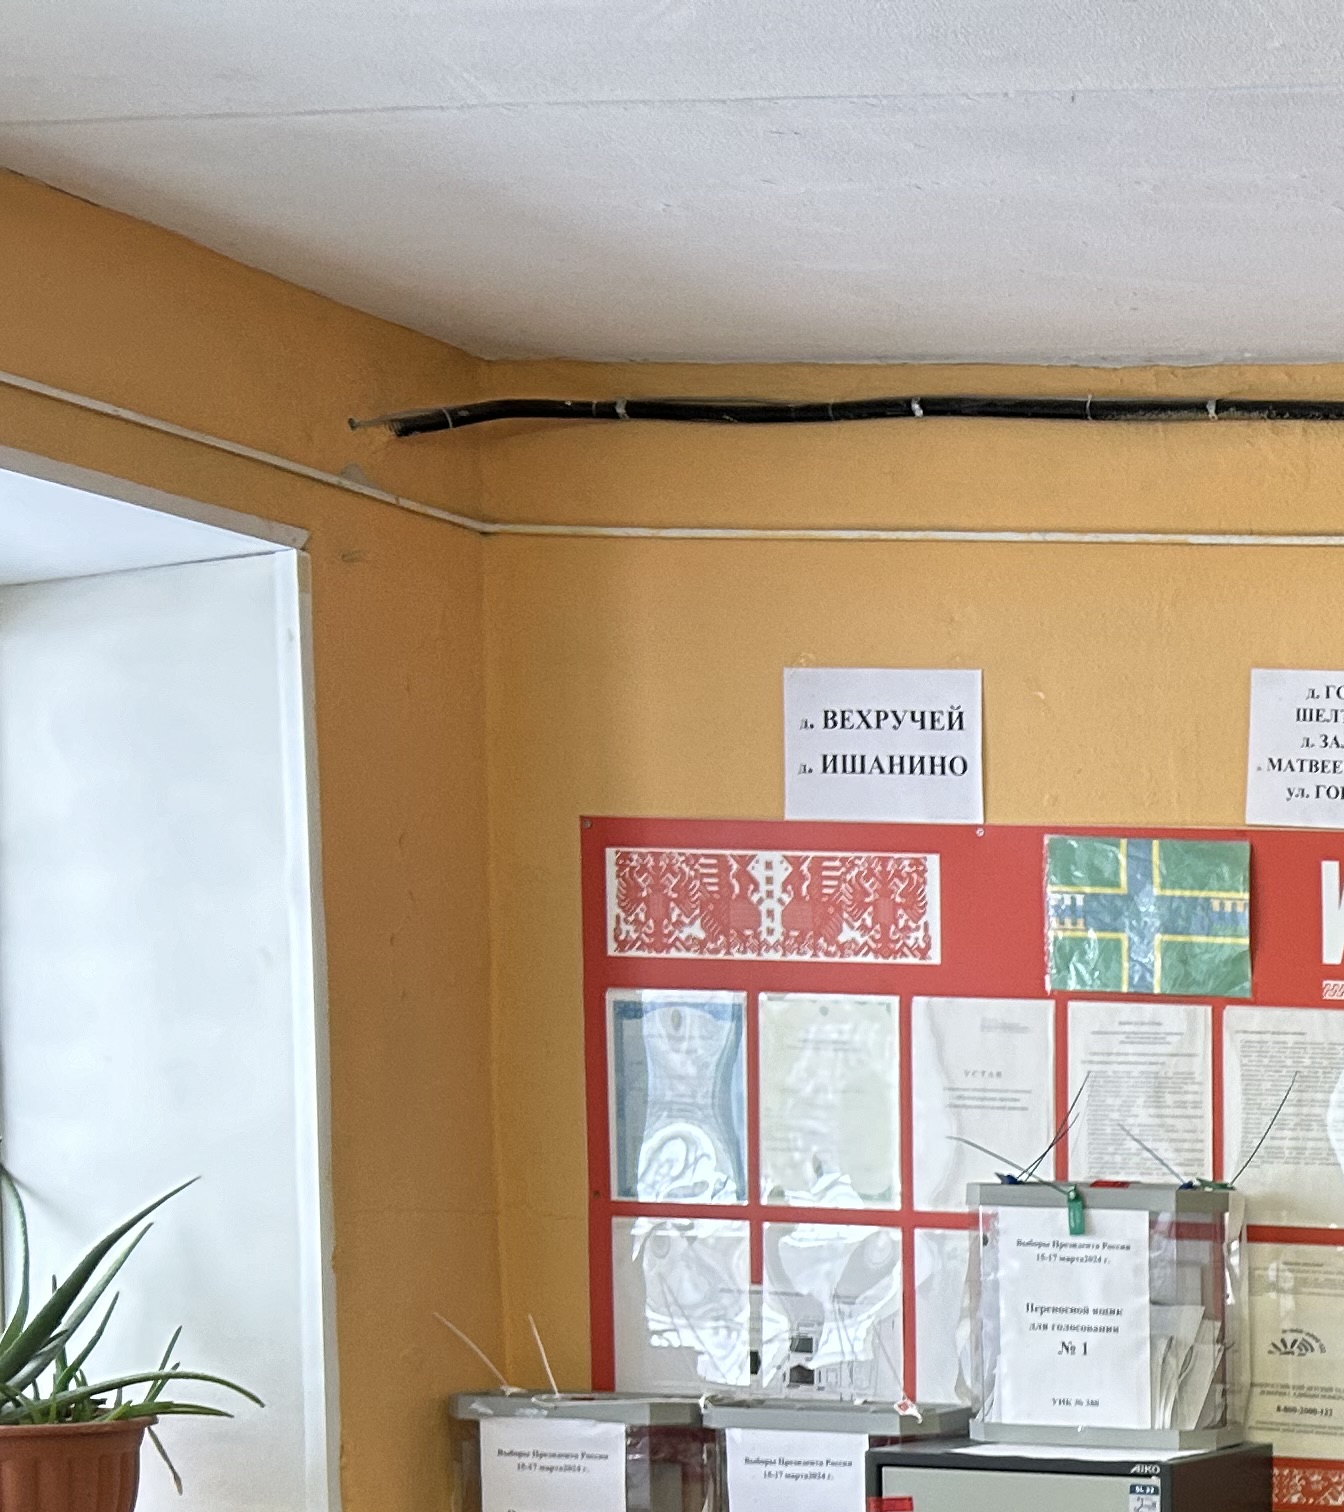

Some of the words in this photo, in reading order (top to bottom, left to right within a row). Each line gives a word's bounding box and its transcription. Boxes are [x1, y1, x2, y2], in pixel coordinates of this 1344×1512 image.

[1306, 688, 1320, 700] д.
[823, 705, 965, 731] ВЕХРУЧЕЙ
[1301, 737, 1315, 749] д.
[821, 754, 968, 776] ИШАНИНО
[1286, 787, 1310, 802] ул.
[1058, 1341, 1076, 1356] №
[1082, 1342, 1088, 1356] 1
[1130, 1464, 1160, 1474] AIKO
